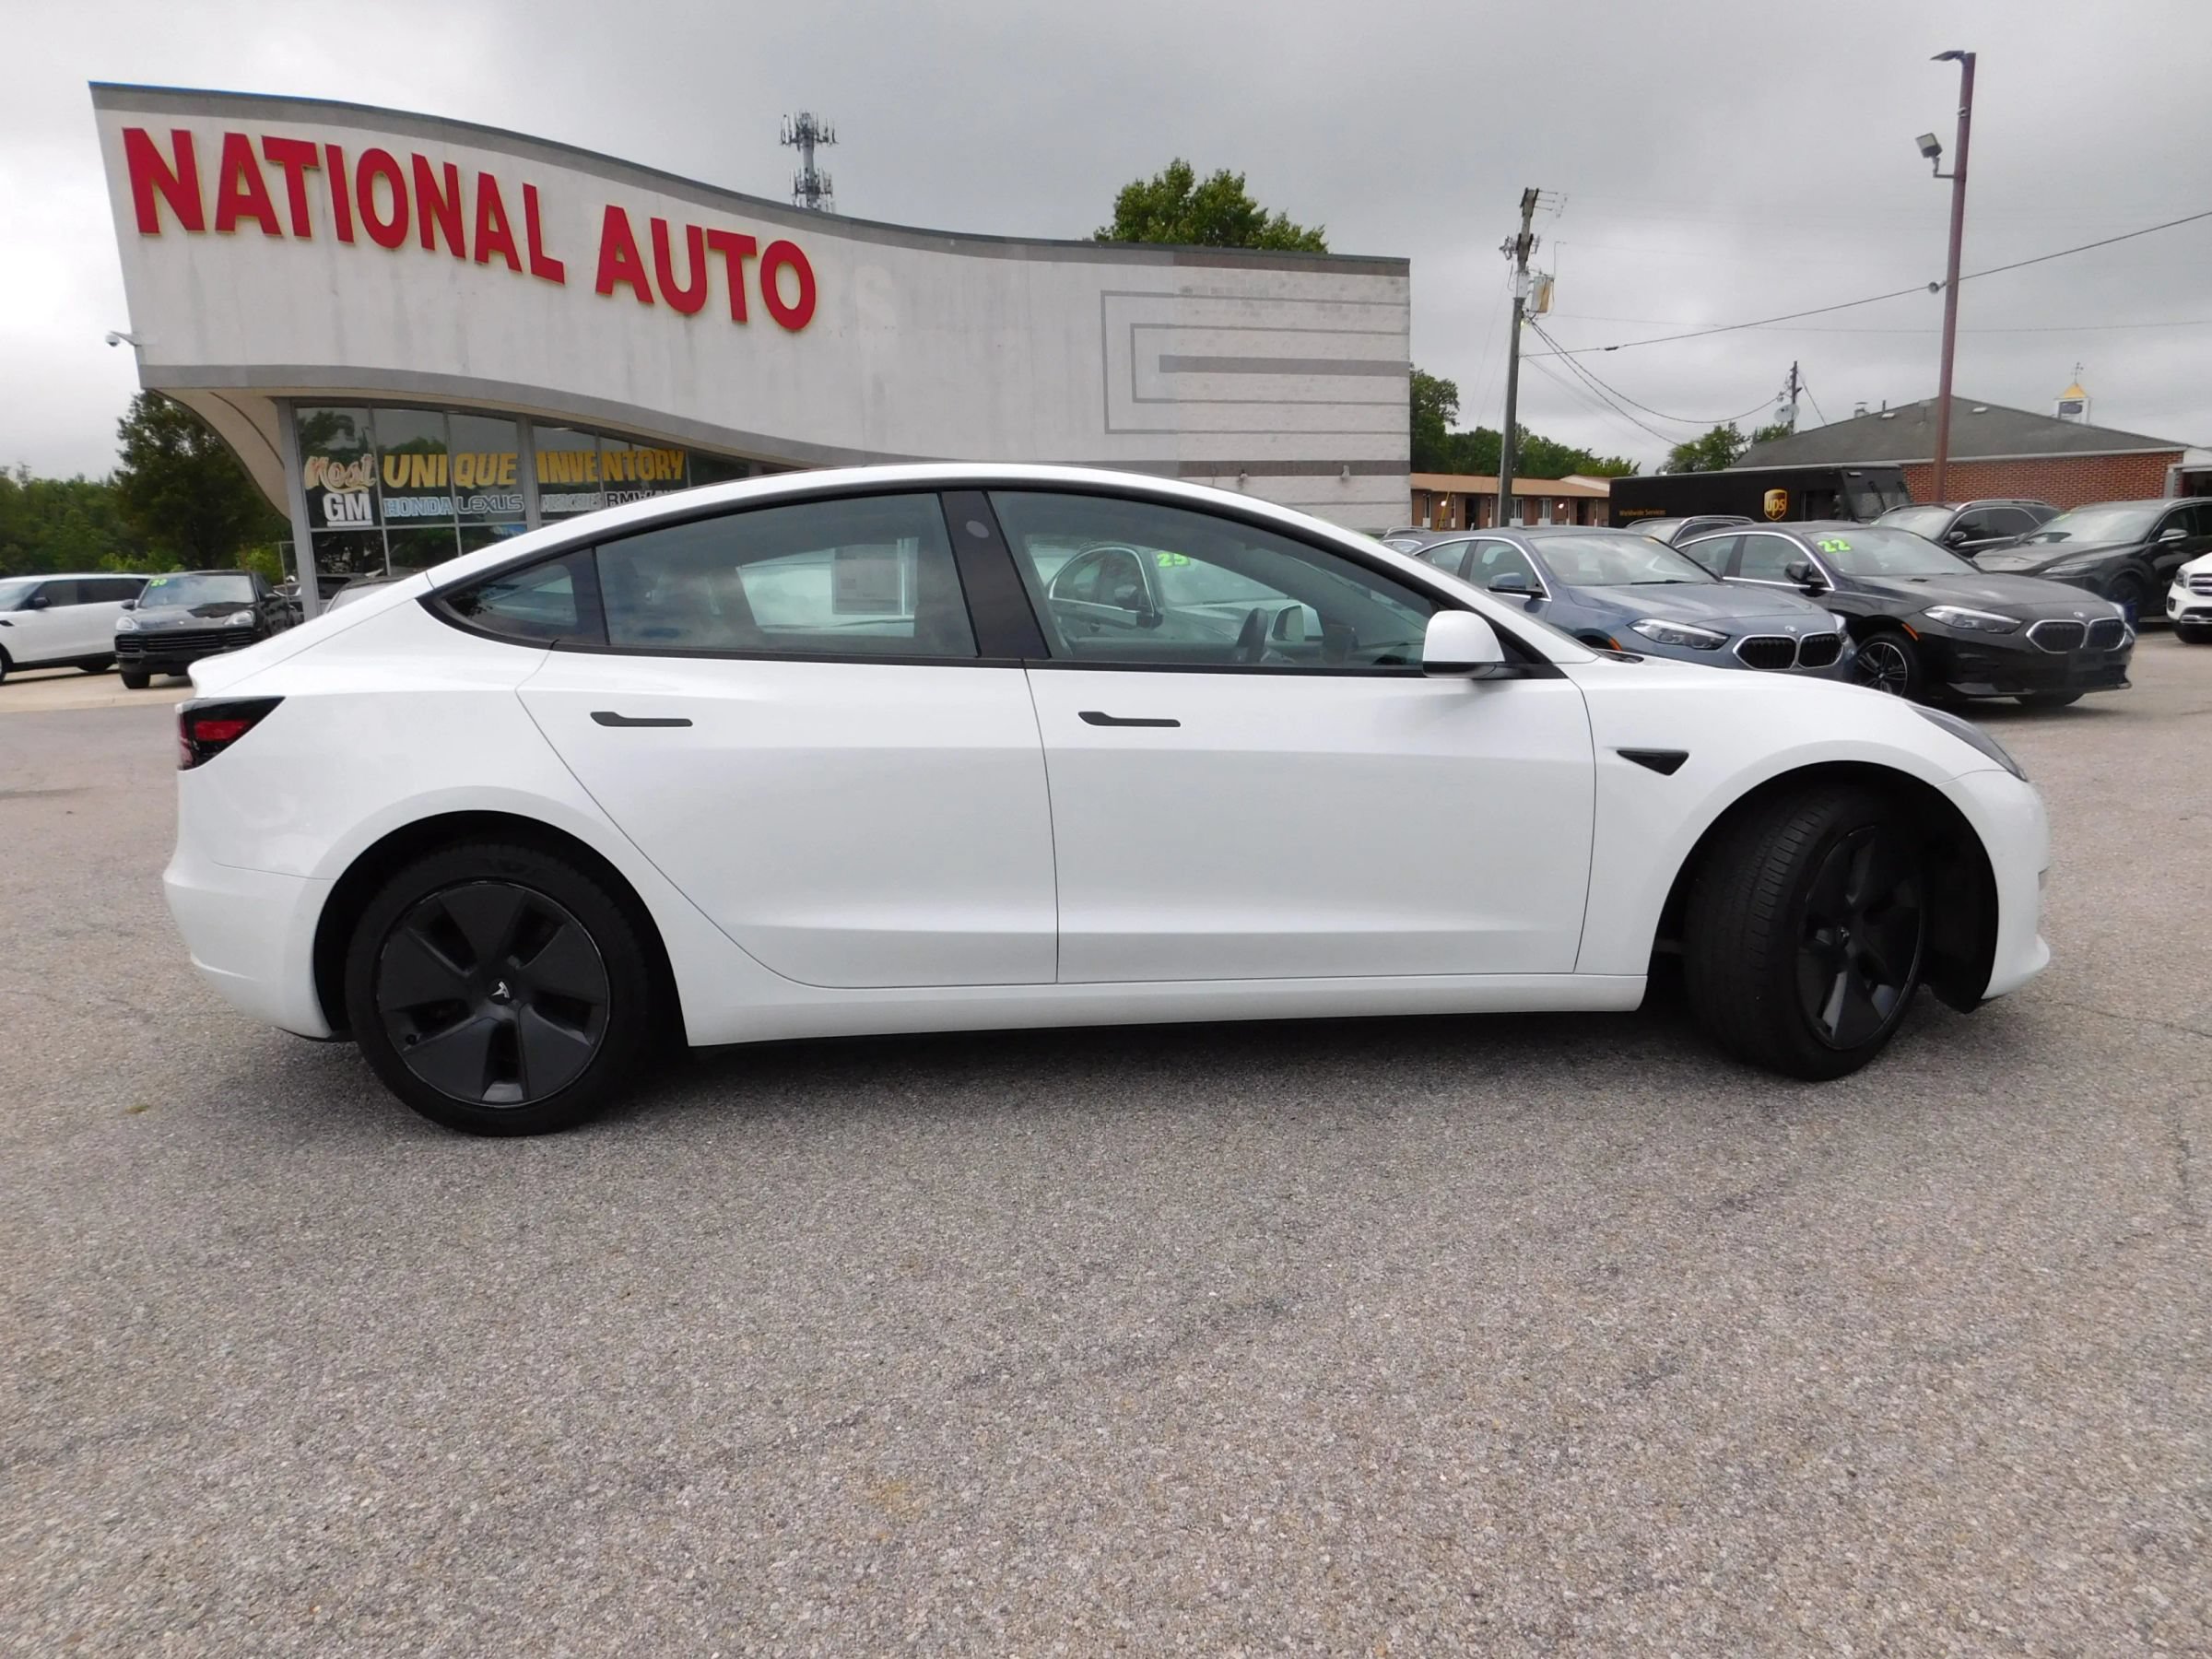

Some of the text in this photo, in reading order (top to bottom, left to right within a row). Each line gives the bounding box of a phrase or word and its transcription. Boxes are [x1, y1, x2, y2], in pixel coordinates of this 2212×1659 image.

[124, 129, 564, 283] NATIONAL
[597, 206, 816, 330] AUTO
[382, 453, 518, 488] UNIQUE
[536, 450, 685, 483] INVENTORY
[323, 493, 372, 521] GM
[382, 496, 453, 518] HONDA
[456, 494, 524, 514] LEXUS
[1645, 508, 1666, 516] Services
[1766, 499, 1785, 515] ups
[1817, 539, 1852, 553] 22
[1157, 552, 1190, 568] 25
